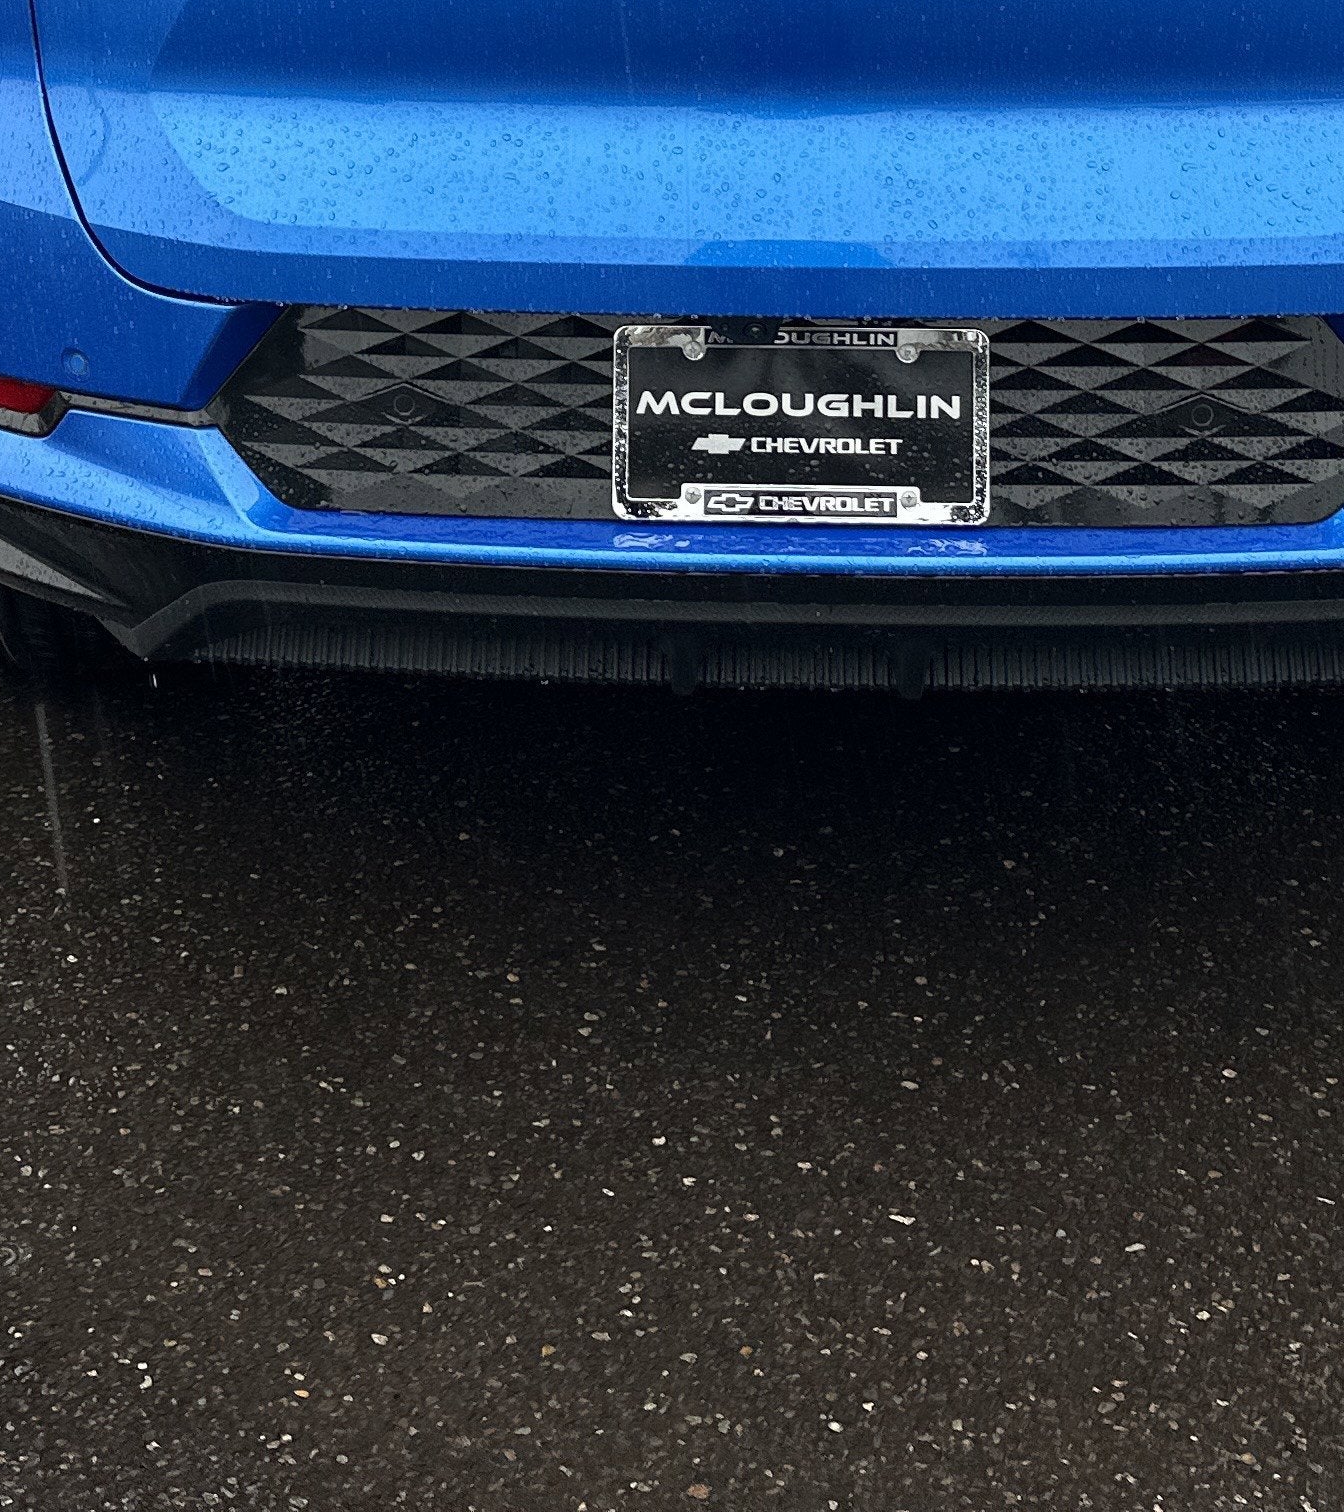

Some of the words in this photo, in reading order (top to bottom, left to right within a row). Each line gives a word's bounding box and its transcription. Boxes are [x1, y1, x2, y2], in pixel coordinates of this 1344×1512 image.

[636, 390, 961, 419] MCLOUGHLIN
[751, 437, 903, 455] CHEVROLET
[758, 494, 895, 513] CHEVROLET
